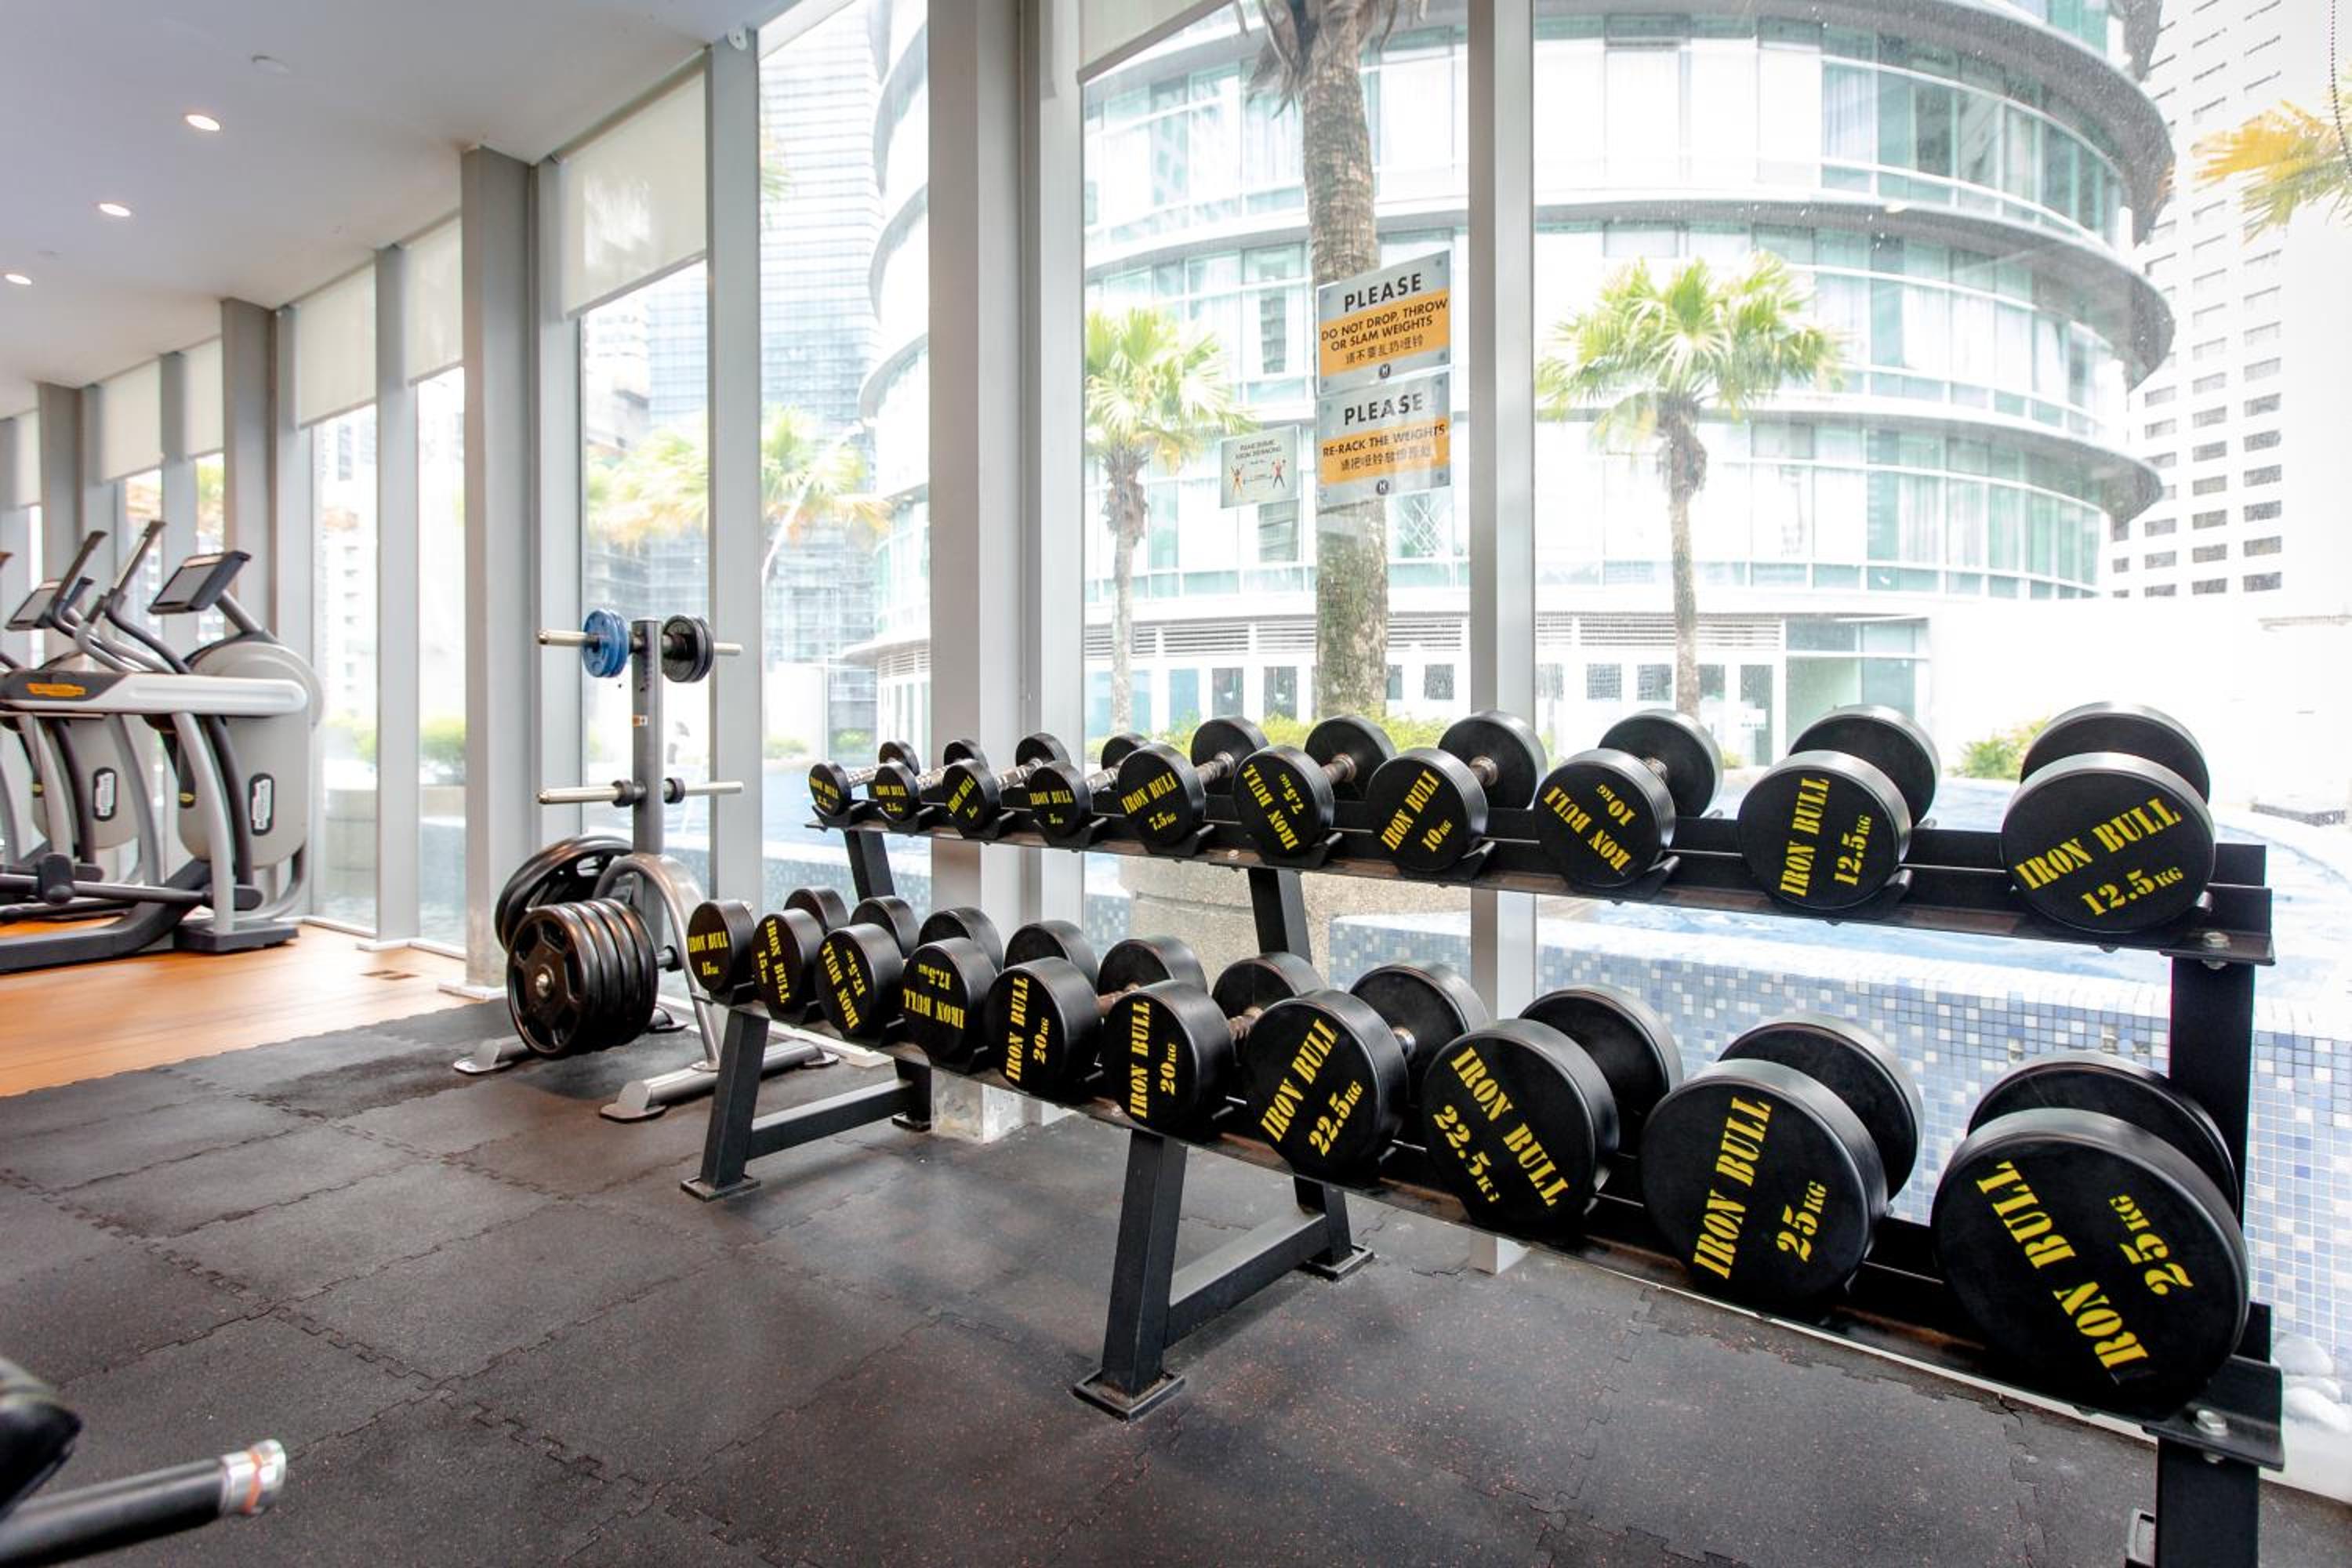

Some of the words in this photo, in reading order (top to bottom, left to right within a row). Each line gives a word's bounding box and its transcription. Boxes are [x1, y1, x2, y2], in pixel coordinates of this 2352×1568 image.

[1345, 274, 1422, 312] PLEASE
[1321, 328, 1338, 341] DO
[1341, 321, 1363, 335] NOT
[1367, 311, 1399, 328] DROP,
[1403, 298, 1448, 318] THROW
[1330, 339, 1347, 351] OR
[1350, 329, 1379, 346] SLAM
[1382, 314, 1433, 338] WEIGHTS
[1345, 393, 1423, 426] PLEASE
[1323, 439, 1367, 457] RE-RACK
[1369, 435, 1390, 448] THE
[1393, 424, 1445, 444] WEIGHTS
[891, 785, 906, 796] BULL
[959, 775, 975, 797] BULL
[1029, 791, 1049, 804] IRON
[1051, 790, 1073, 804] BULL
[1121, 788, 1149, 814] IRON
[1148, 772, 1177, 799] BULL
[1243, 764, 1273, 808] BULL
[1544, 786, 1592, 833] BULL
[1596, 785, 1635, 826] 10KG
[1792, 777, 1829, 835] BULL
[1268, 809, 1299, 851] IRON
[1381, 810, 1414, 851] IRON
[1405, 770, 1439, 813] BULL
[1421, 820, 1452, 851] 10KG
[1835, 815, 1871, 885] 12.5KG
[2016, 837, 2092, 890] IRON
[2092, 797, 2181, 853] BULL
[1780, 840, 1816, 897] IRON
[2082, 867, 2183, 916] 12.5KG
[708, 931, 728, 949] BULL
[766, 919, 782, 956] IRON
[774, 962, 789, 1004] BULL
[822, 942, 843, 985] BULL
[837, 987, 859, 1029] IRON
[902, 988, 931, 1017] BULL
[936, 1000, 965, 1029] IRON
[1011, 978, 1029, 1026] BULL
[1131, 1002, 1150, 1057] BULL
[1006, 1032, 1024, 1081] IRON
[1160, 1043, 1177, 1095] 20KG
[1261, 1078, 1304, 1142] IRON
[1292, 1018, 1338, 1084] BULL
[1130, 1062, 1149, 1119] IRON
[1308, 1080, 1363, 1156] 22.5KG
[1450, 1047, 1512, 1121] IRON
[1504, 1123, 1569, 1207] BULL
[1715, 1097, 1772, 1186] BULL
[1693, 1189, 1746, 1279] IRON
[1776, 1181, 1827, 1261] 25KG
[1976, 1160, 2075, 1269] BULL
[2109, 1195, 2193, 1295] 25KG
